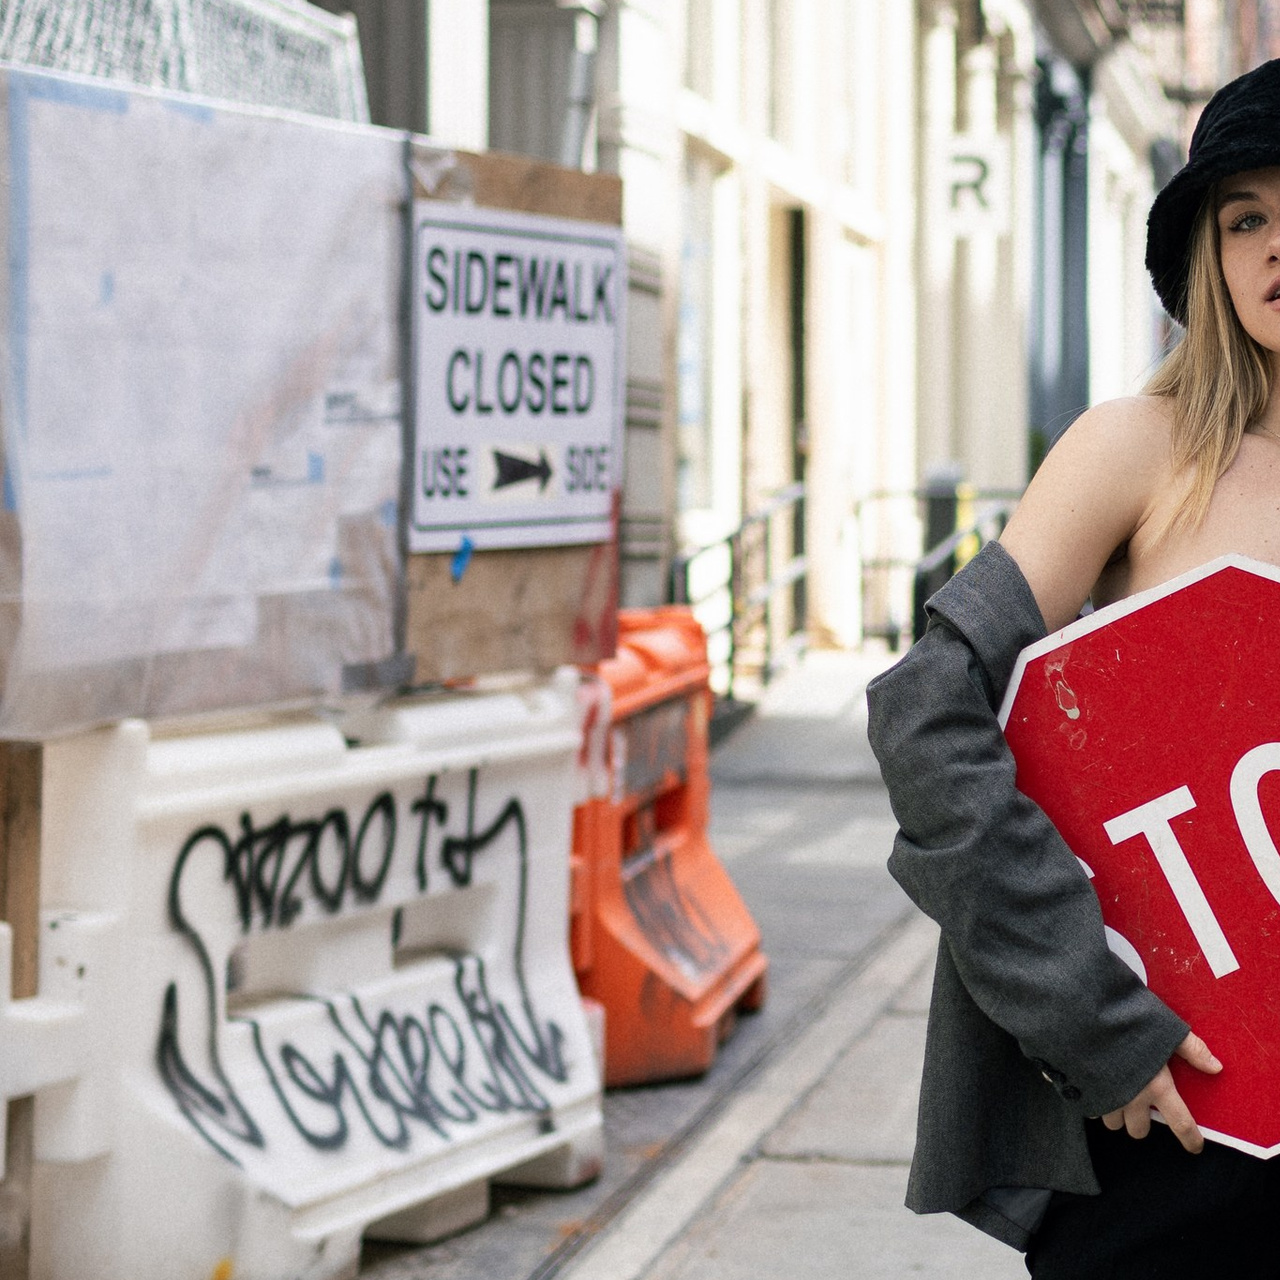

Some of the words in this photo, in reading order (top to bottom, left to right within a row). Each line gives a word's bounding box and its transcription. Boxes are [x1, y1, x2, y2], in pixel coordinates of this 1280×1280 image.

[424, 245, 617, 323] SIDEWALK
[446, 349, 594, 415] CLOSED
[422, 447, 469, 498] USE
